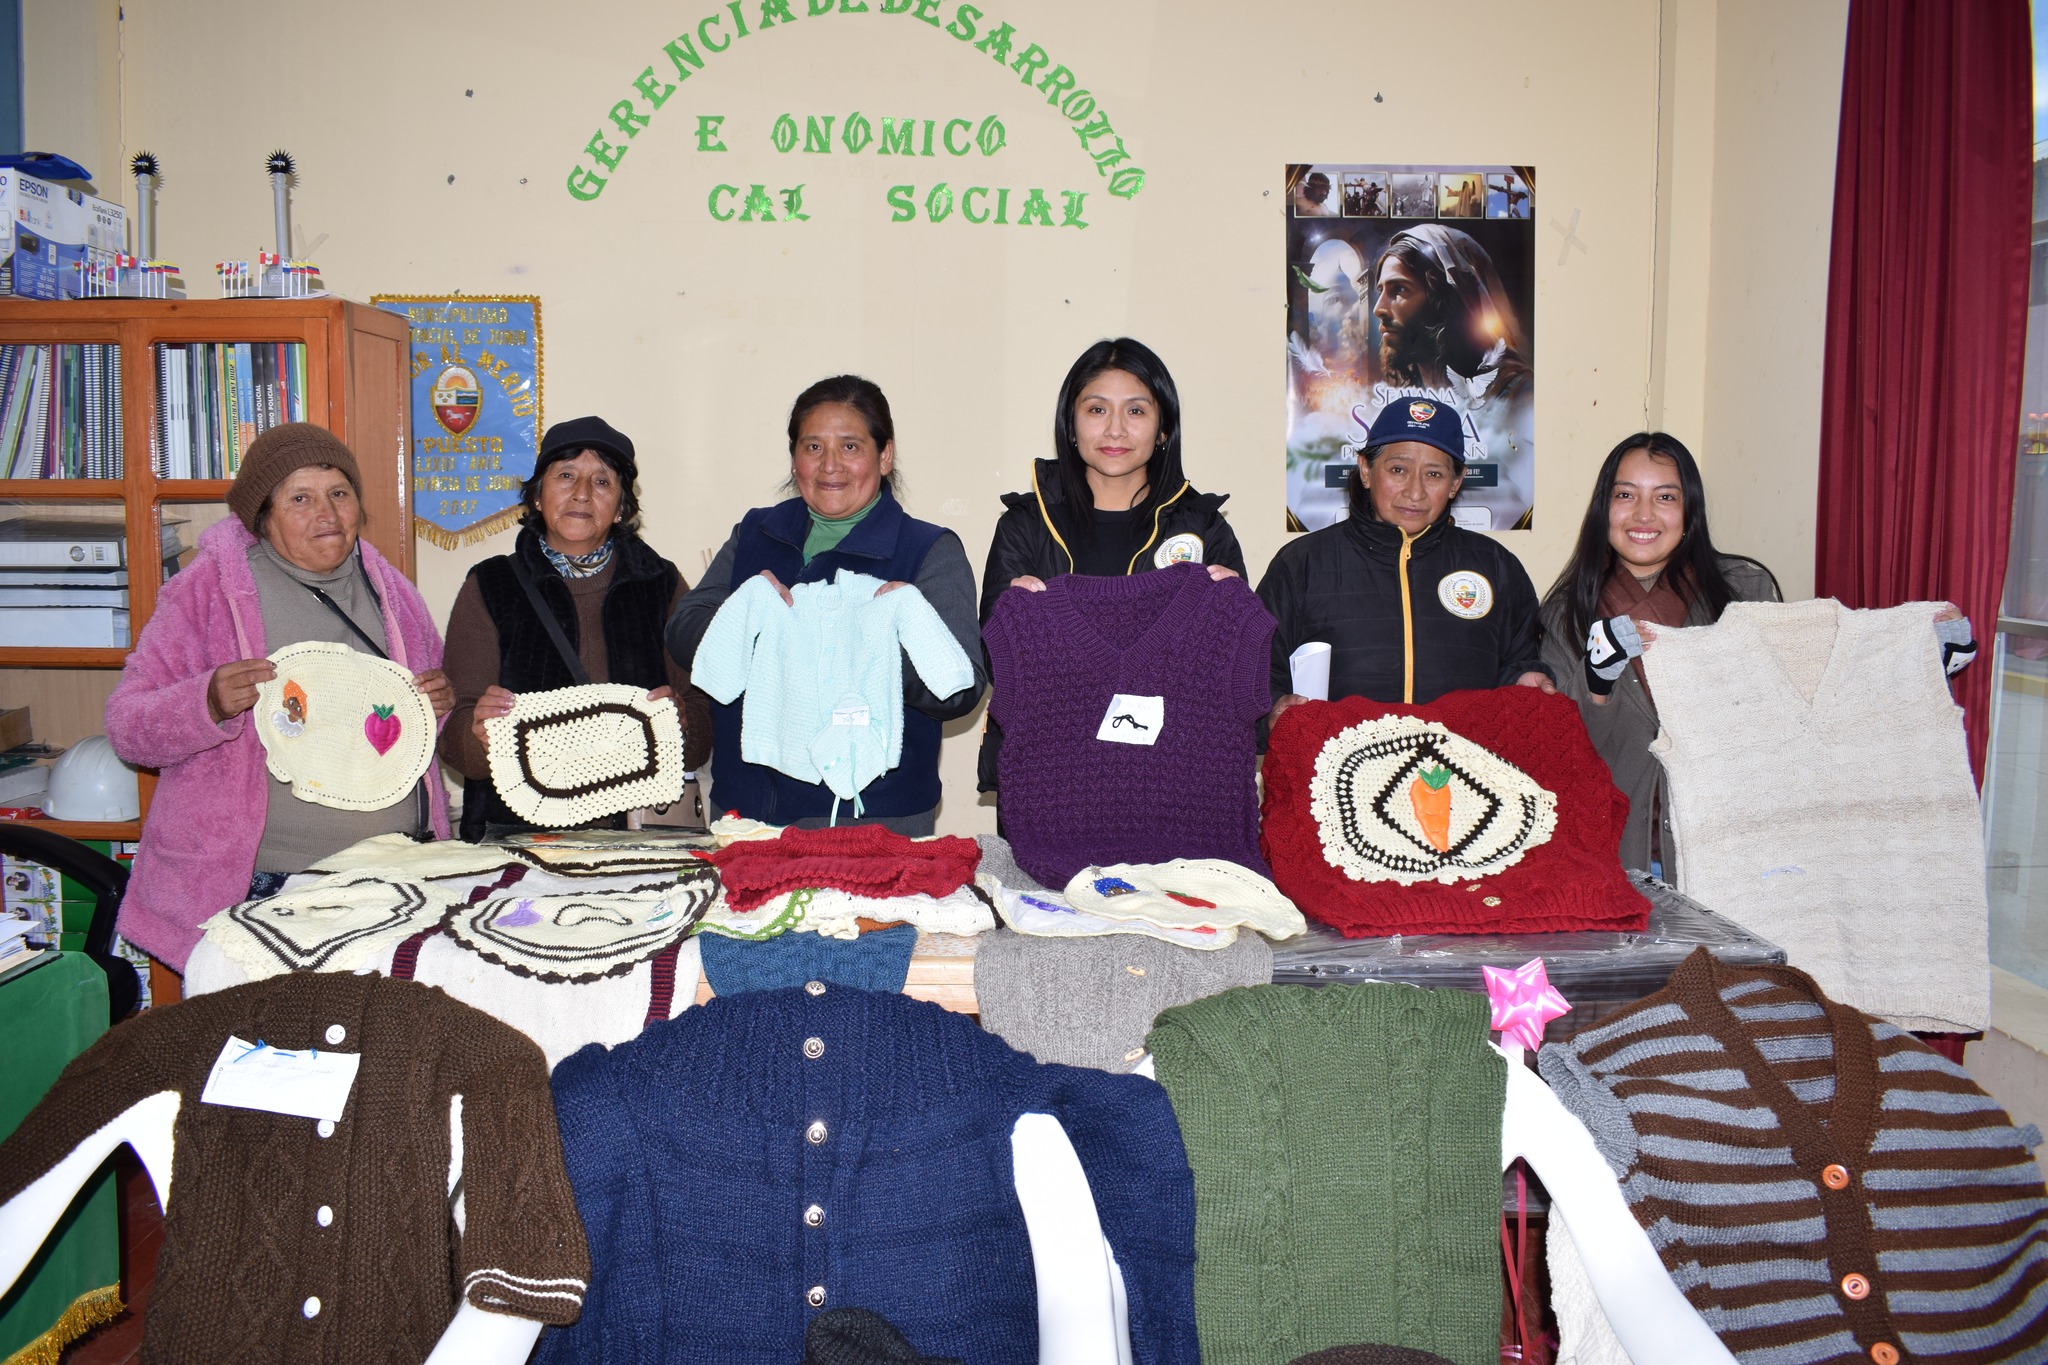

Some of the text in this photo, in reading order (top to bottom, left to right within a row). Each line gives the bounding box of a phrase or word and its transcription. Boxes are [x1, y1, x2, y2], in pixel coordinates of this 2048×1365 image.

[567, 0, 798, 201] GERENCIA
[694, 111, 1007, 157] E ONOMICO
[20, 178, 48, 199] EPSON
[107, 208, 122, 219] L3250
[708, 182, 1090, 230] CAL SOCIAL
[409, 327, 527, 346] VINCIAL DE JUNIN
[441, 341, 466, 364] AL
[476, 349, 534, 417] MERITO
[231, 399, 239, 446] PERFORMANCE
[423, 436, 503, 453] PUESTO
[1464, 446, 1487, 458] NÍN
[465, 475, 480, 491] DE
[440, 500, 477, 515] 2017
